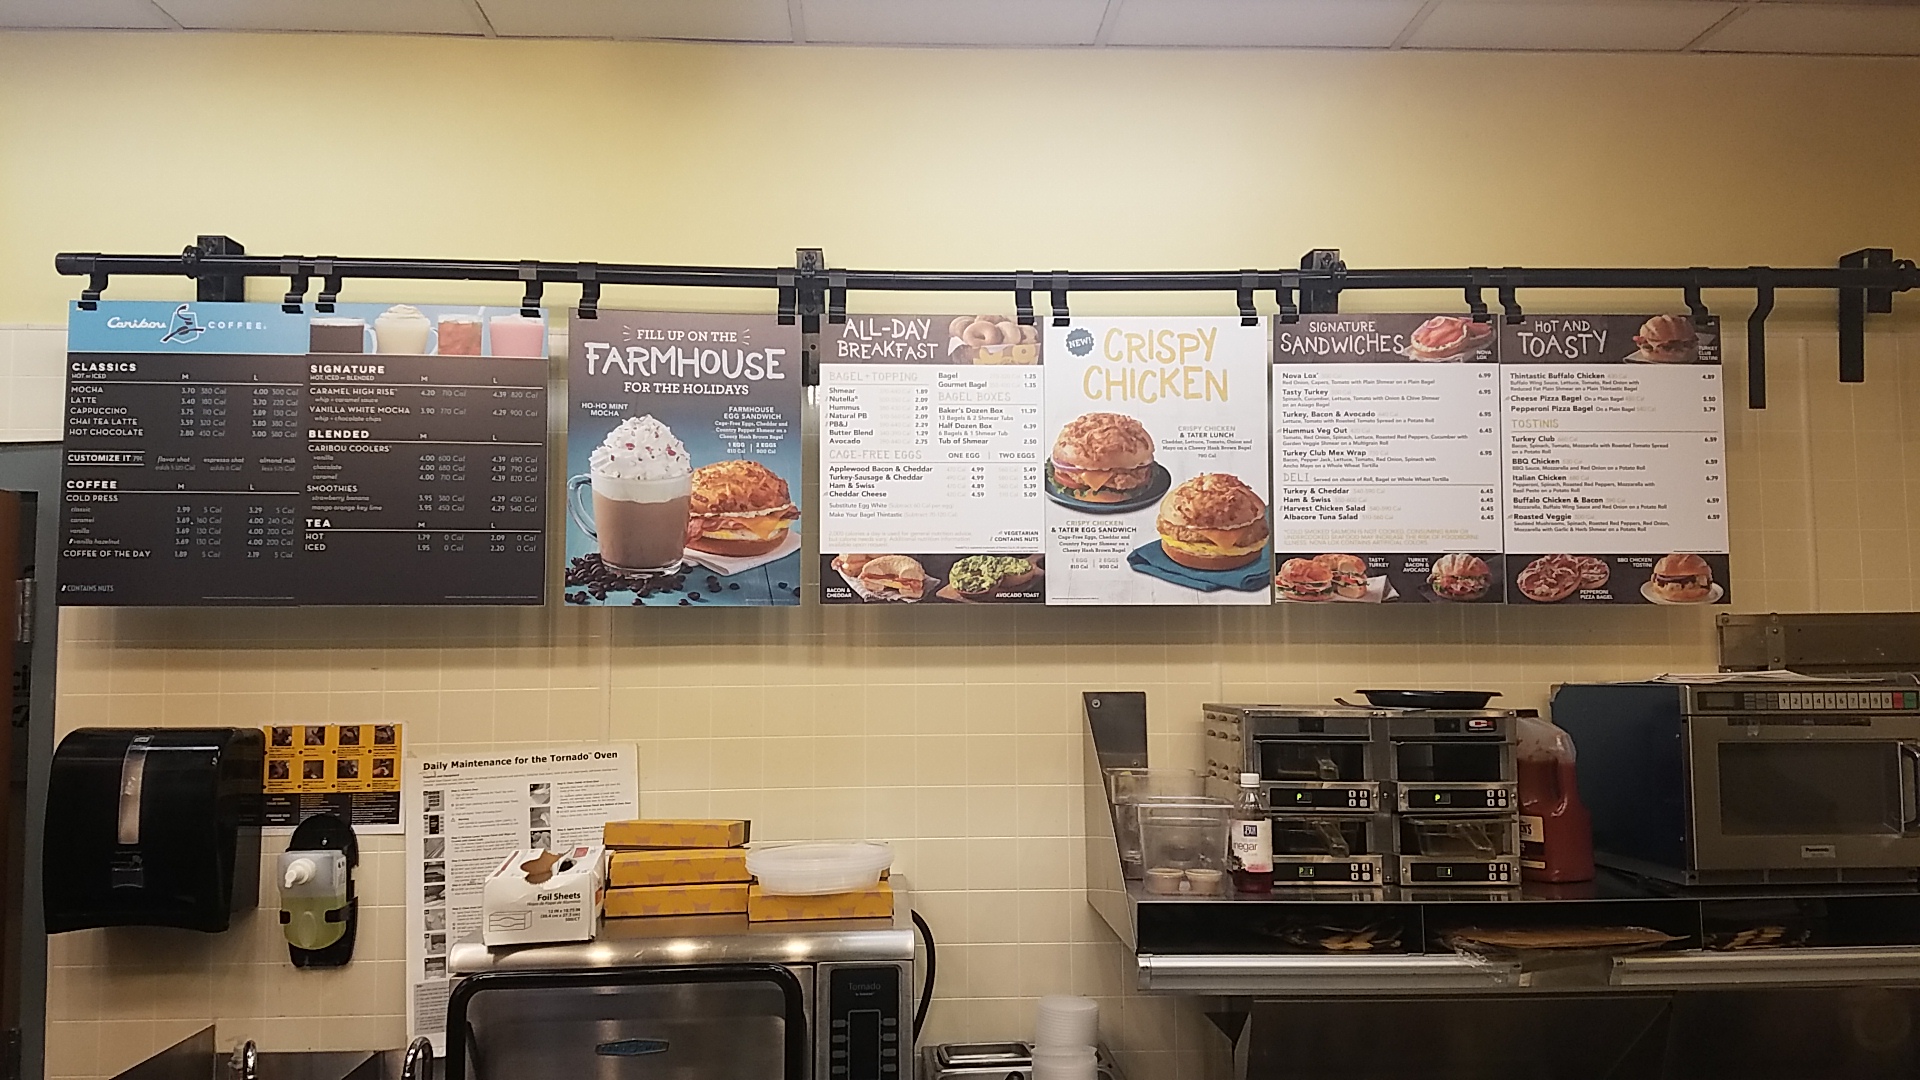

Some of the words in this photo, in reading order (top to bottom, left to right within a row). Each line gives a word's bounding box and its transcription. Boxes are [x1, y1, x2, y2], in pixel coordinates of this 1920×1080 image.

[106, 317, 167, 329] Caribou
[1309, 321, 1376, 334] SIGNATURE
[1535, 320, 1559, 332] HOT
[1563, 320, 1591, 331] AND
[843, 318, 931, 341] ALL-DAY
[637, 330, 664, 340] FILL
[666, 330, 685, 341] UP
[687, 331, 709, 342] ON
[710, 331, 737, 342] THE
[1068, 338, 1091, 349] NEW!
[1104, 327, 1217, 365] CRISPY
[1280, 332, 1404, 355] SANDWICHES
[1517, 330, 1608, 359] TOASTY
[837, 340, 939, 360] BREAKFAST
[584, 342, 786, 380] FARMHOUSE
[71, 363, 137, 372] CLASSICS
[310, 365, 385, 374] SIGNATURE
[938, 372, 958, 380] Bagel
[624, 382, 651, 393] FOR
[653, 383, 680, 394] THE
[682, 384, 749, 395] HOLIDAYS
[969, 381, 987, 389] Bagel
[1083, 365, 1228, 403] CHICKEN
[938, 392, 972, 401] BAGEL
[977, 392, 1011, 401] BOXES
[1304, 388, 1329, 396] Turkey
[1561, 395, 1582, 403] Bagel
[70, 407, 127, 415] CAPPUCCINO
[377, 406, 410, 414] MOCHA
[1511, 405, 1549, 413] Pepperoni
[1573, 405, 1593, 413] Bagel
[111, 418, 138, 426] LATTE
[1511, 419, 1559, 428] TOSTINIS
[308, 430, 370, 439] BLENDED
[1511, 436, 1536, 444] Turkey
[68, 454, 120, 462] CUSTOMIZE
[122, 454, 131, 462] IT
[829, 450, 890, 460] CAGE-FREE
[894, 450, 922, 460] EGGS
[1282, 450, 1307, 458] Turkey
[829, 466, 870, 474] Applewood
[1283, 473, 1309, 482] DELI
[66, 481, 117, 489] COFFEE
[306, 519, 331, 528] TEA
[423, 760, 447, 772] Daily
[451, 757, 512, 769] Maintenance
[514, 756, 529, 765] for
[531, 755, 547, 764] the
[594, 751, 618, 760] Oven
[537, 893, 552, 901] Foil
[849, 982, 881, 990] Tornado
